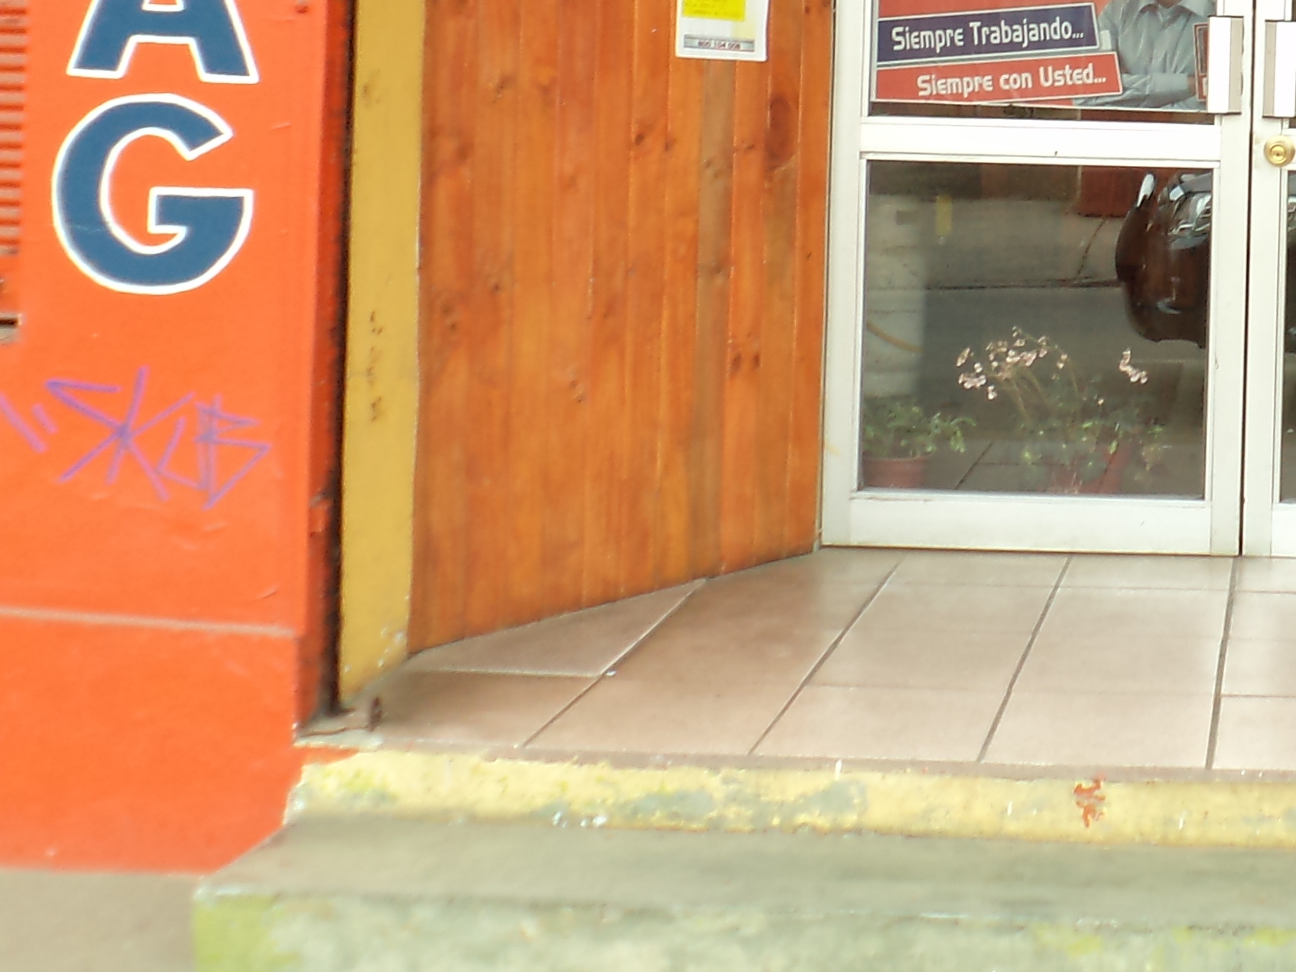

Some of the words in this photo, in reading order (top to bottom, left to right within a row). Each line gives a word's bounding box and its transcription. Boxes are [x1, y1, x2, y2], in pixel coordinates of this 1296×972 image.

[891, 26, 965, 54] Siempre
[968, 16, 1084, 48] Trabajando...
[916, 74, 993, 99] Siempre
[999, 71, 1033, 90] con
[1038, 62, 1107, 88] Usted...
